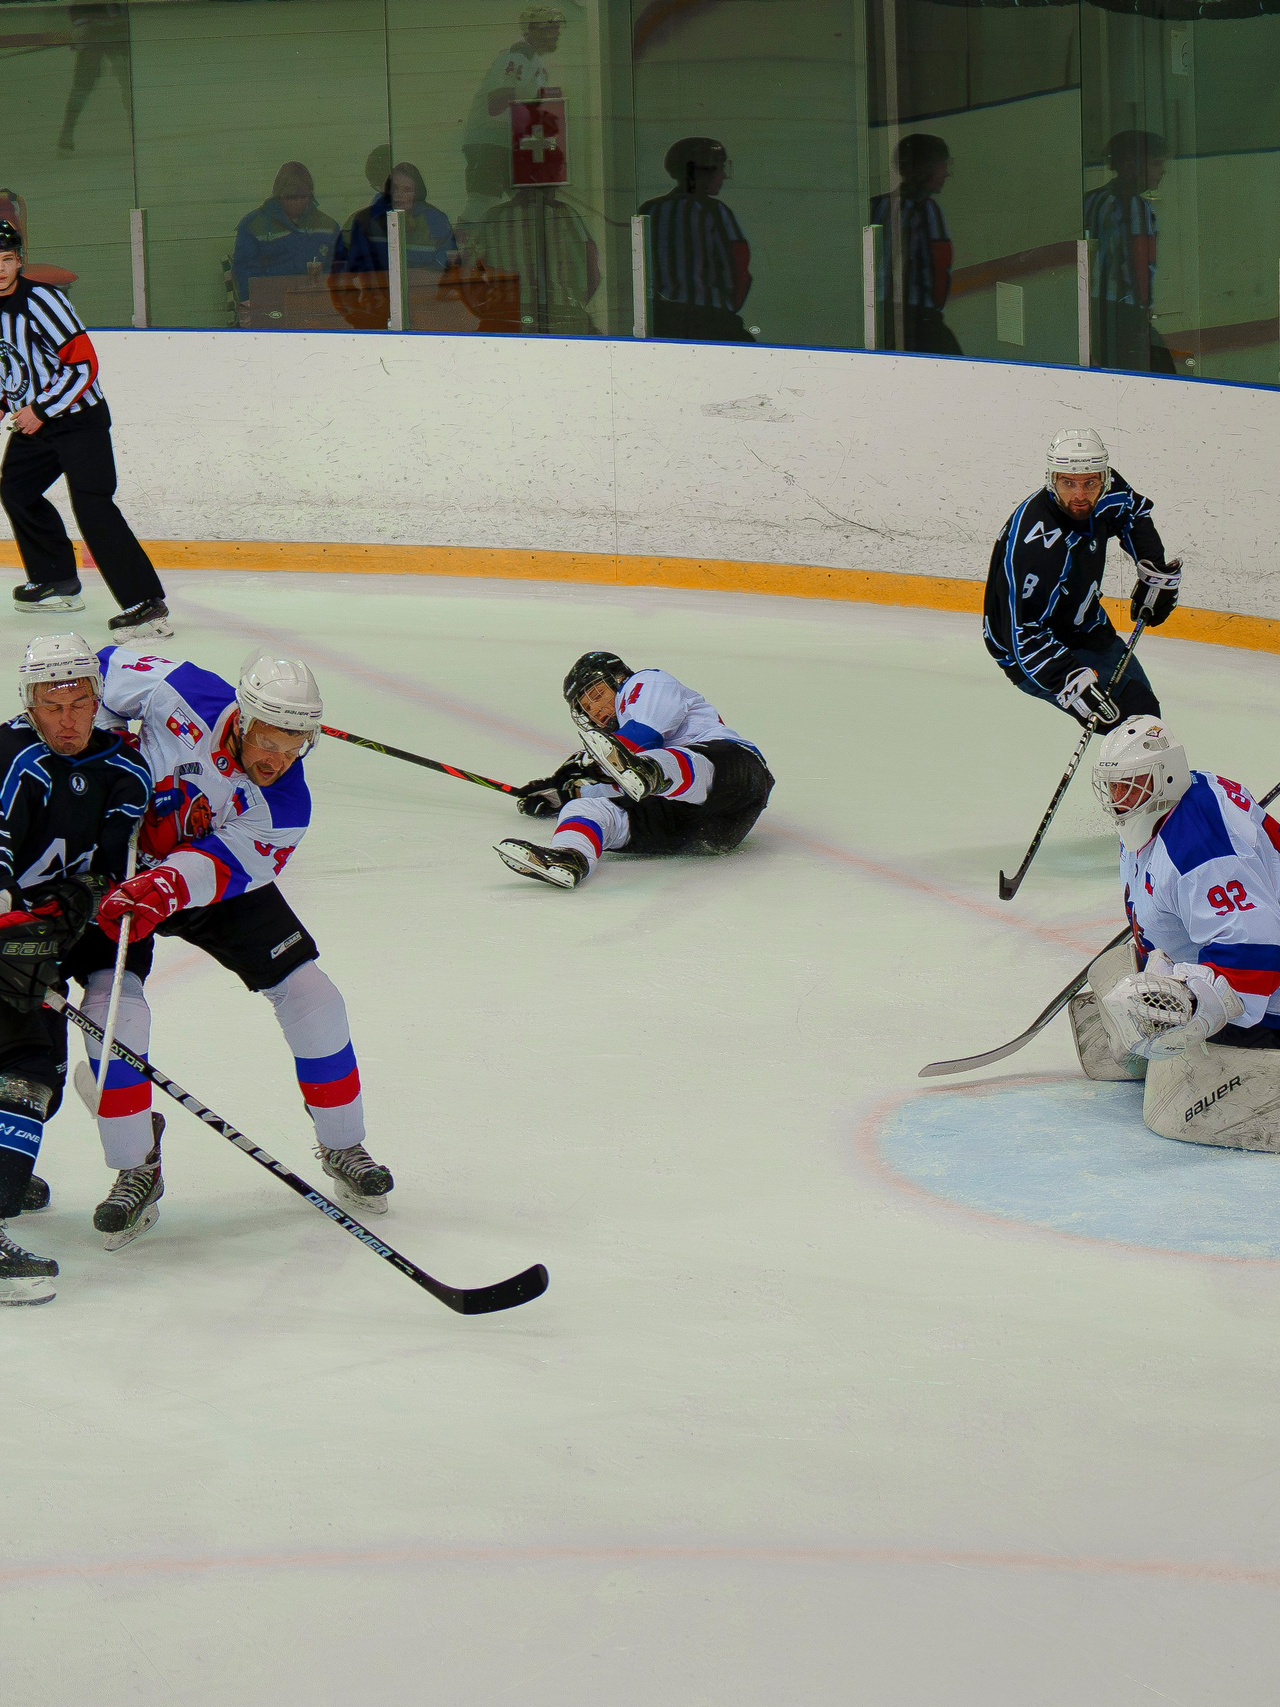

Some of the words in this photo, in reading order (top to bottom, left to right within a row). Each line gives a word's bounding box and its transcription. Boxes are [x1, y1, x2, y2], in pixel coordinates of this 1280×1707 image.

[1021, 573, 1040, 600] 8
[1206, 879, 1258, 916] 92
[2, 941, 59, 956] BAU
[65, 1008, 145, 1072] DOMIATOR
